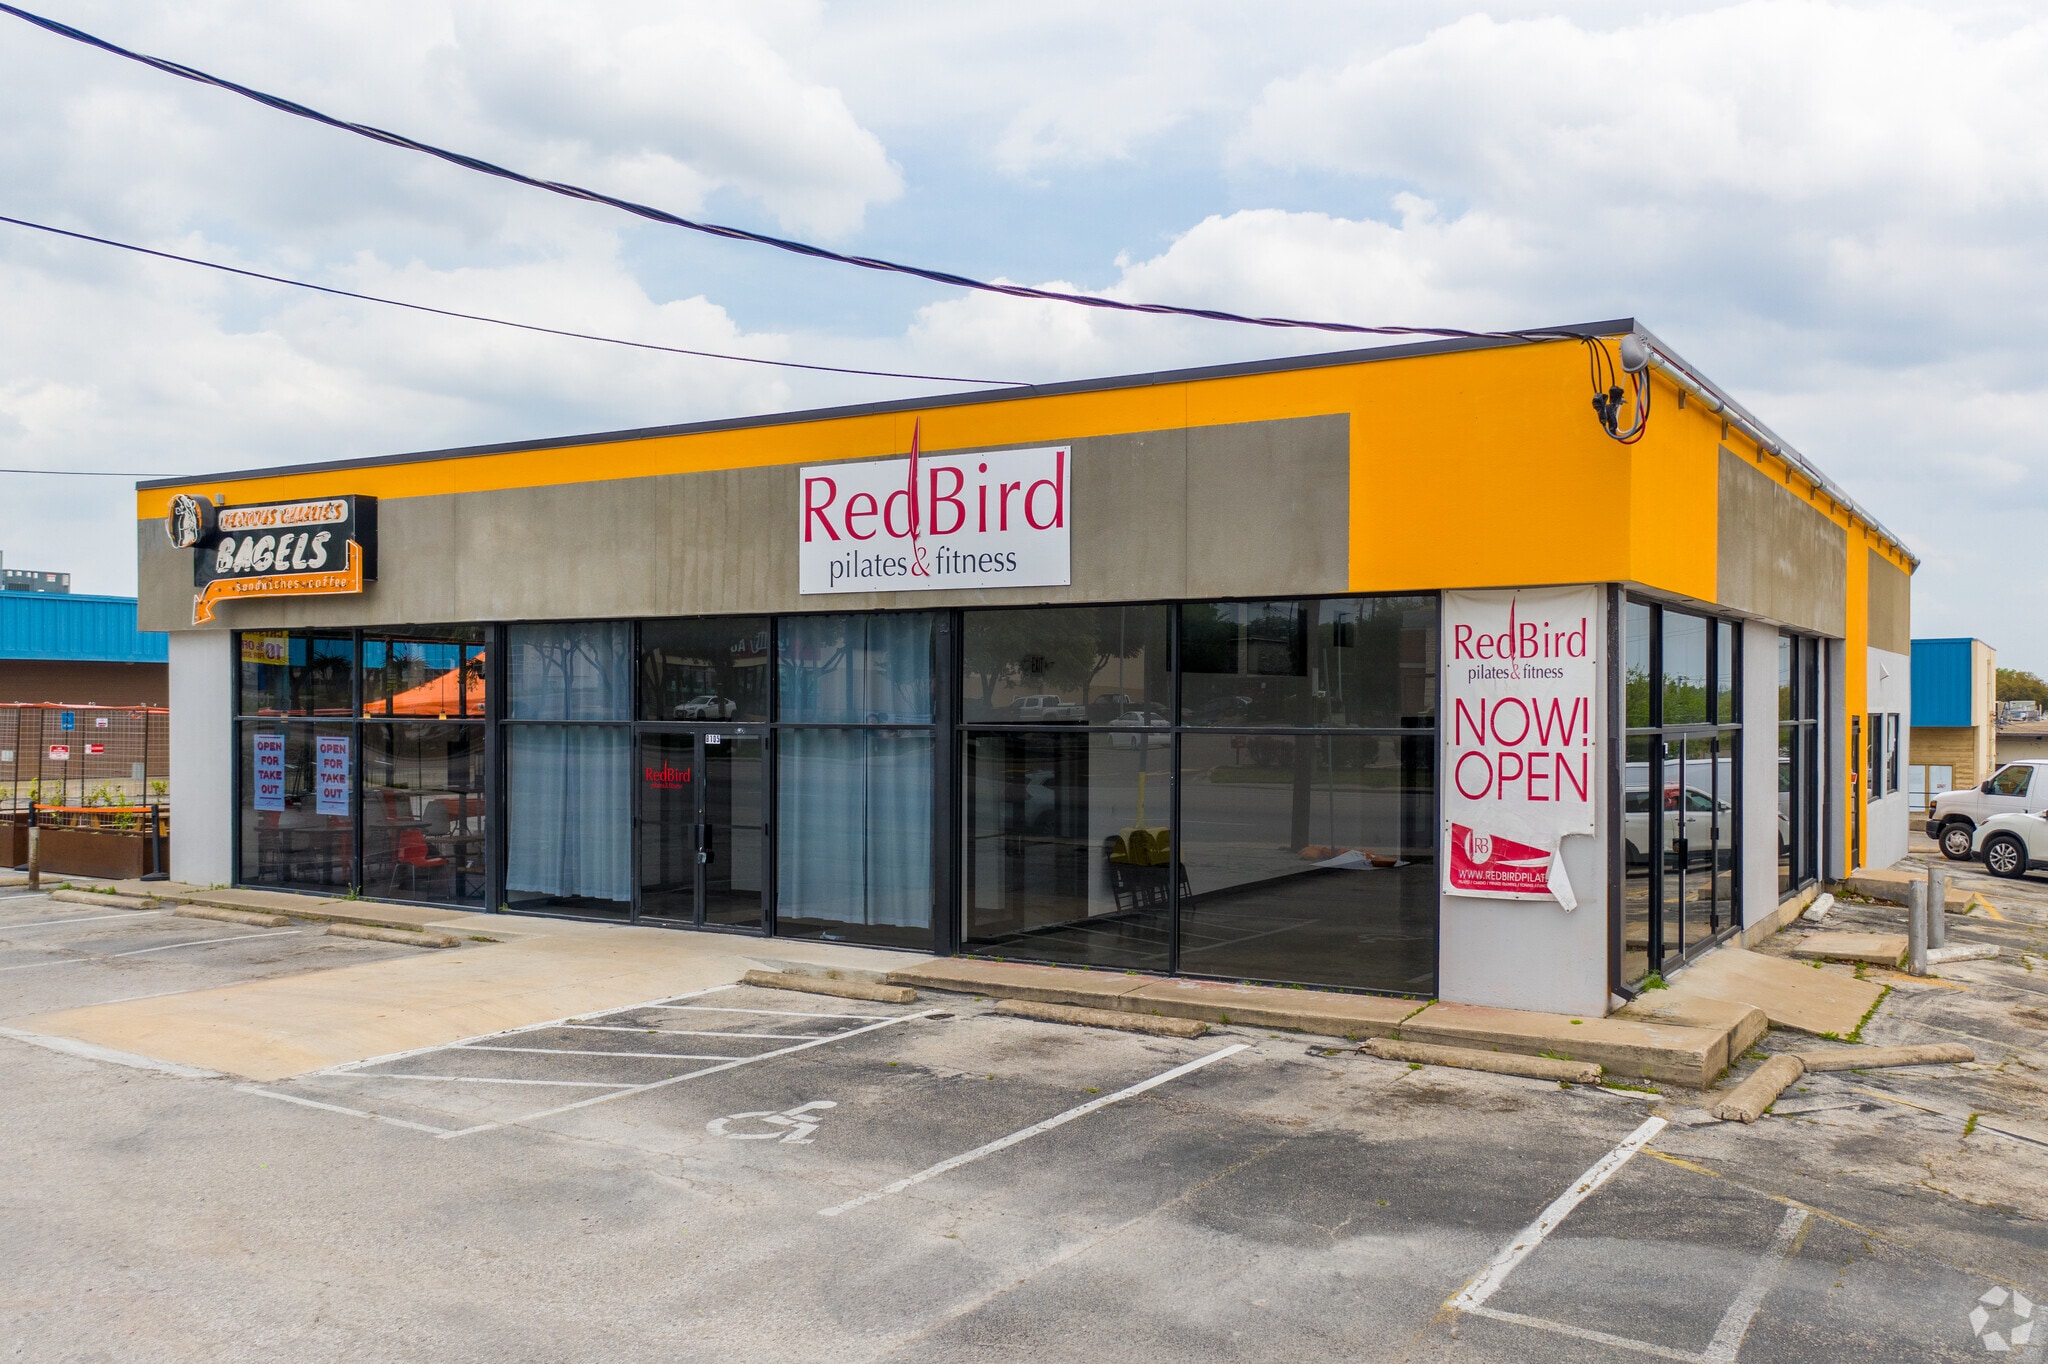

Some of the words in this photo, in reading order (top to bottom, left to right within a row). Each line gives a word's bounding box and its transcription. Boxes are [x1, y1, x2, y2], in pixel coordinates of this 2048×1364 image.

[804, 416, 1065, 543] RedBird
[216, 531, 332, 574] BAGELS
[830, 549, 907, 588] pilates
[911, 546, 930, 577] &
[935, 545, 1017, 575] fitness
[236, 578, 299, 592] sandwiches
[308, 575, 347, 589] coffee
[1454, 595, 1587, 661] RedBird
[1468, 664, 1509, 684] pilates
[1510, 663, 1520, 680] &
[1523, 663, 1564, 680] fitness
[1455, 697, 1588, 747] NOW!
[257, 742, 282, 751] OPEN
[320, 744, 346, 754] OPEN
[261, 756, 279, 766] FOR
[323, 758, 343, 769] FOR
[258, 770, 282, 780] TAKE
[320, 773, 346, 784] TAKE
[645, 759, 691, 782] RedBird
[1454, 751, 1588, 802] OPEN
[261, 784, 279, 794] OUT
[323, 788, 343, 798] OUT
